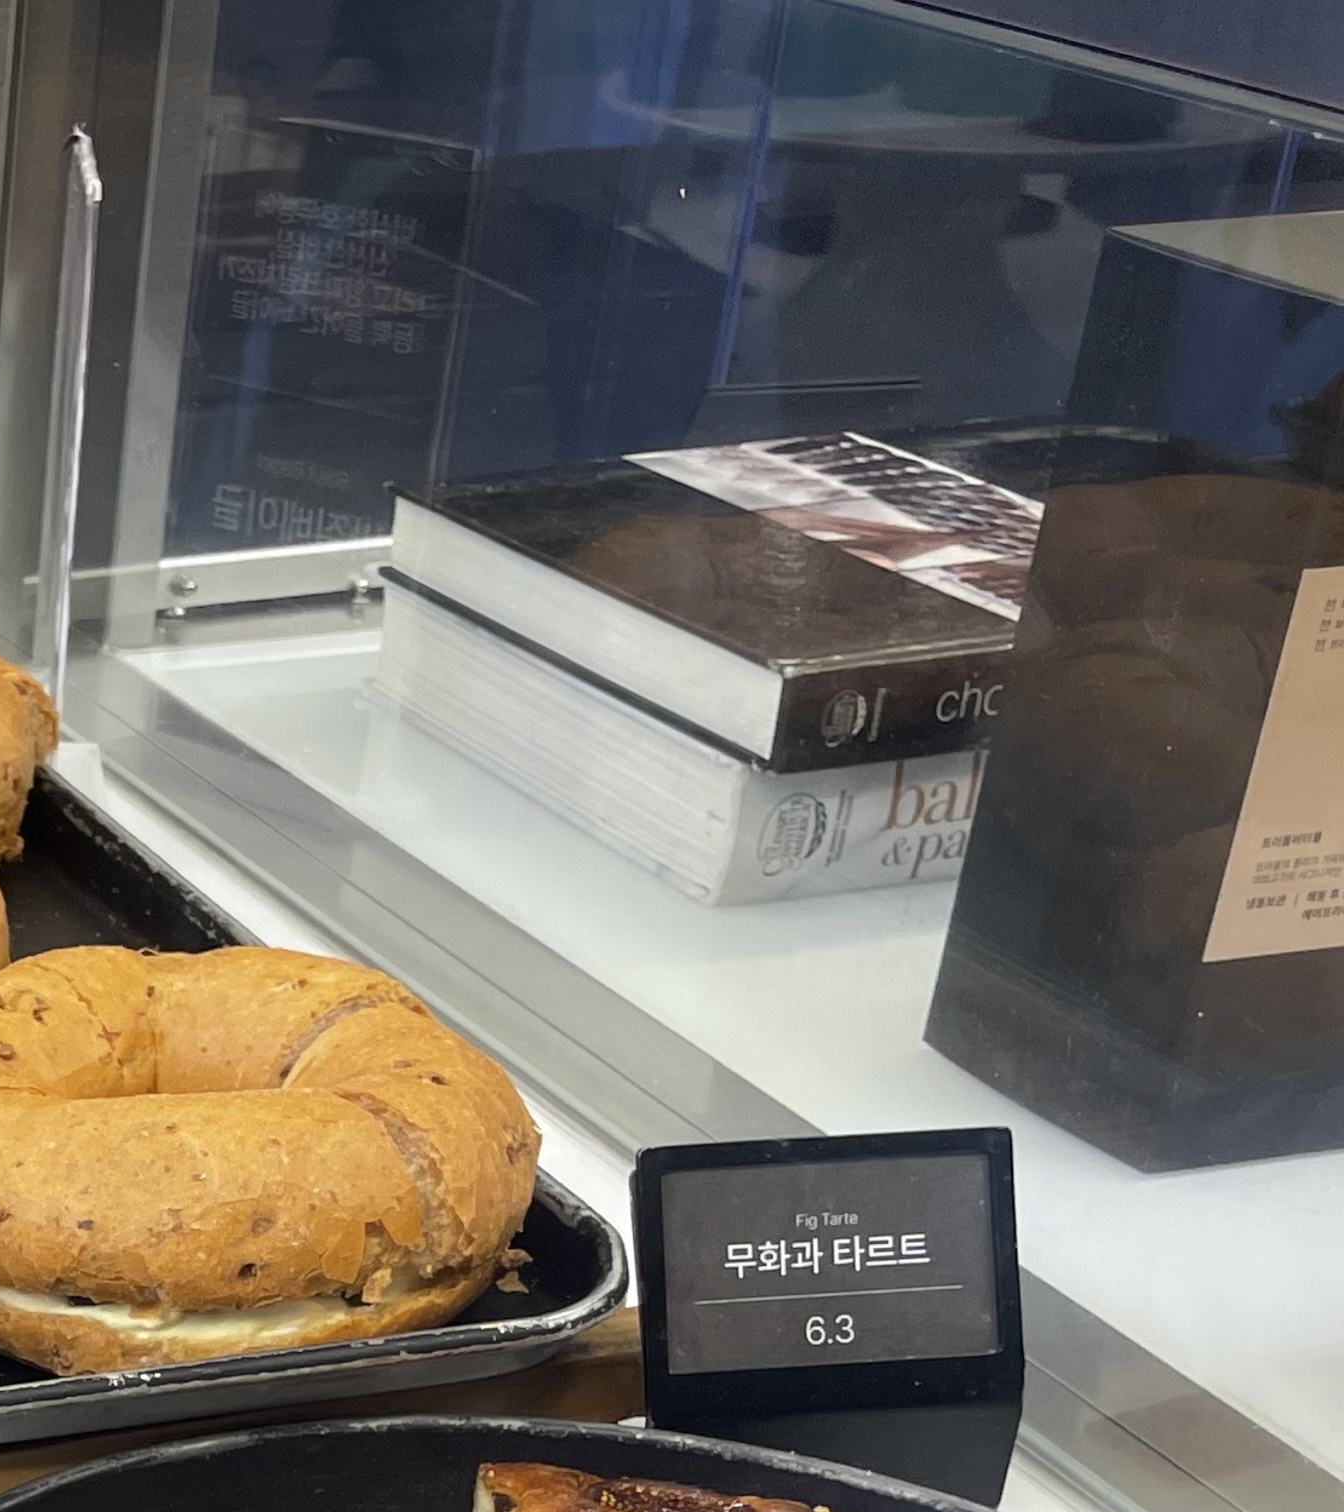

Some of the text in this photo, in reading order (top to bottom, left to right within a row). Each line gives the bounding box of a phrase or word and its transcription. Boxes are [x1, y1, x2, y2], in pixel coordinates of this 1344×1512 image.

[795, 1212, 858, 1230] Fig Tarte
[724, 1234, 931, 1279] 무화과 타르트
[805, 1314, 855, 1345] 6.3
